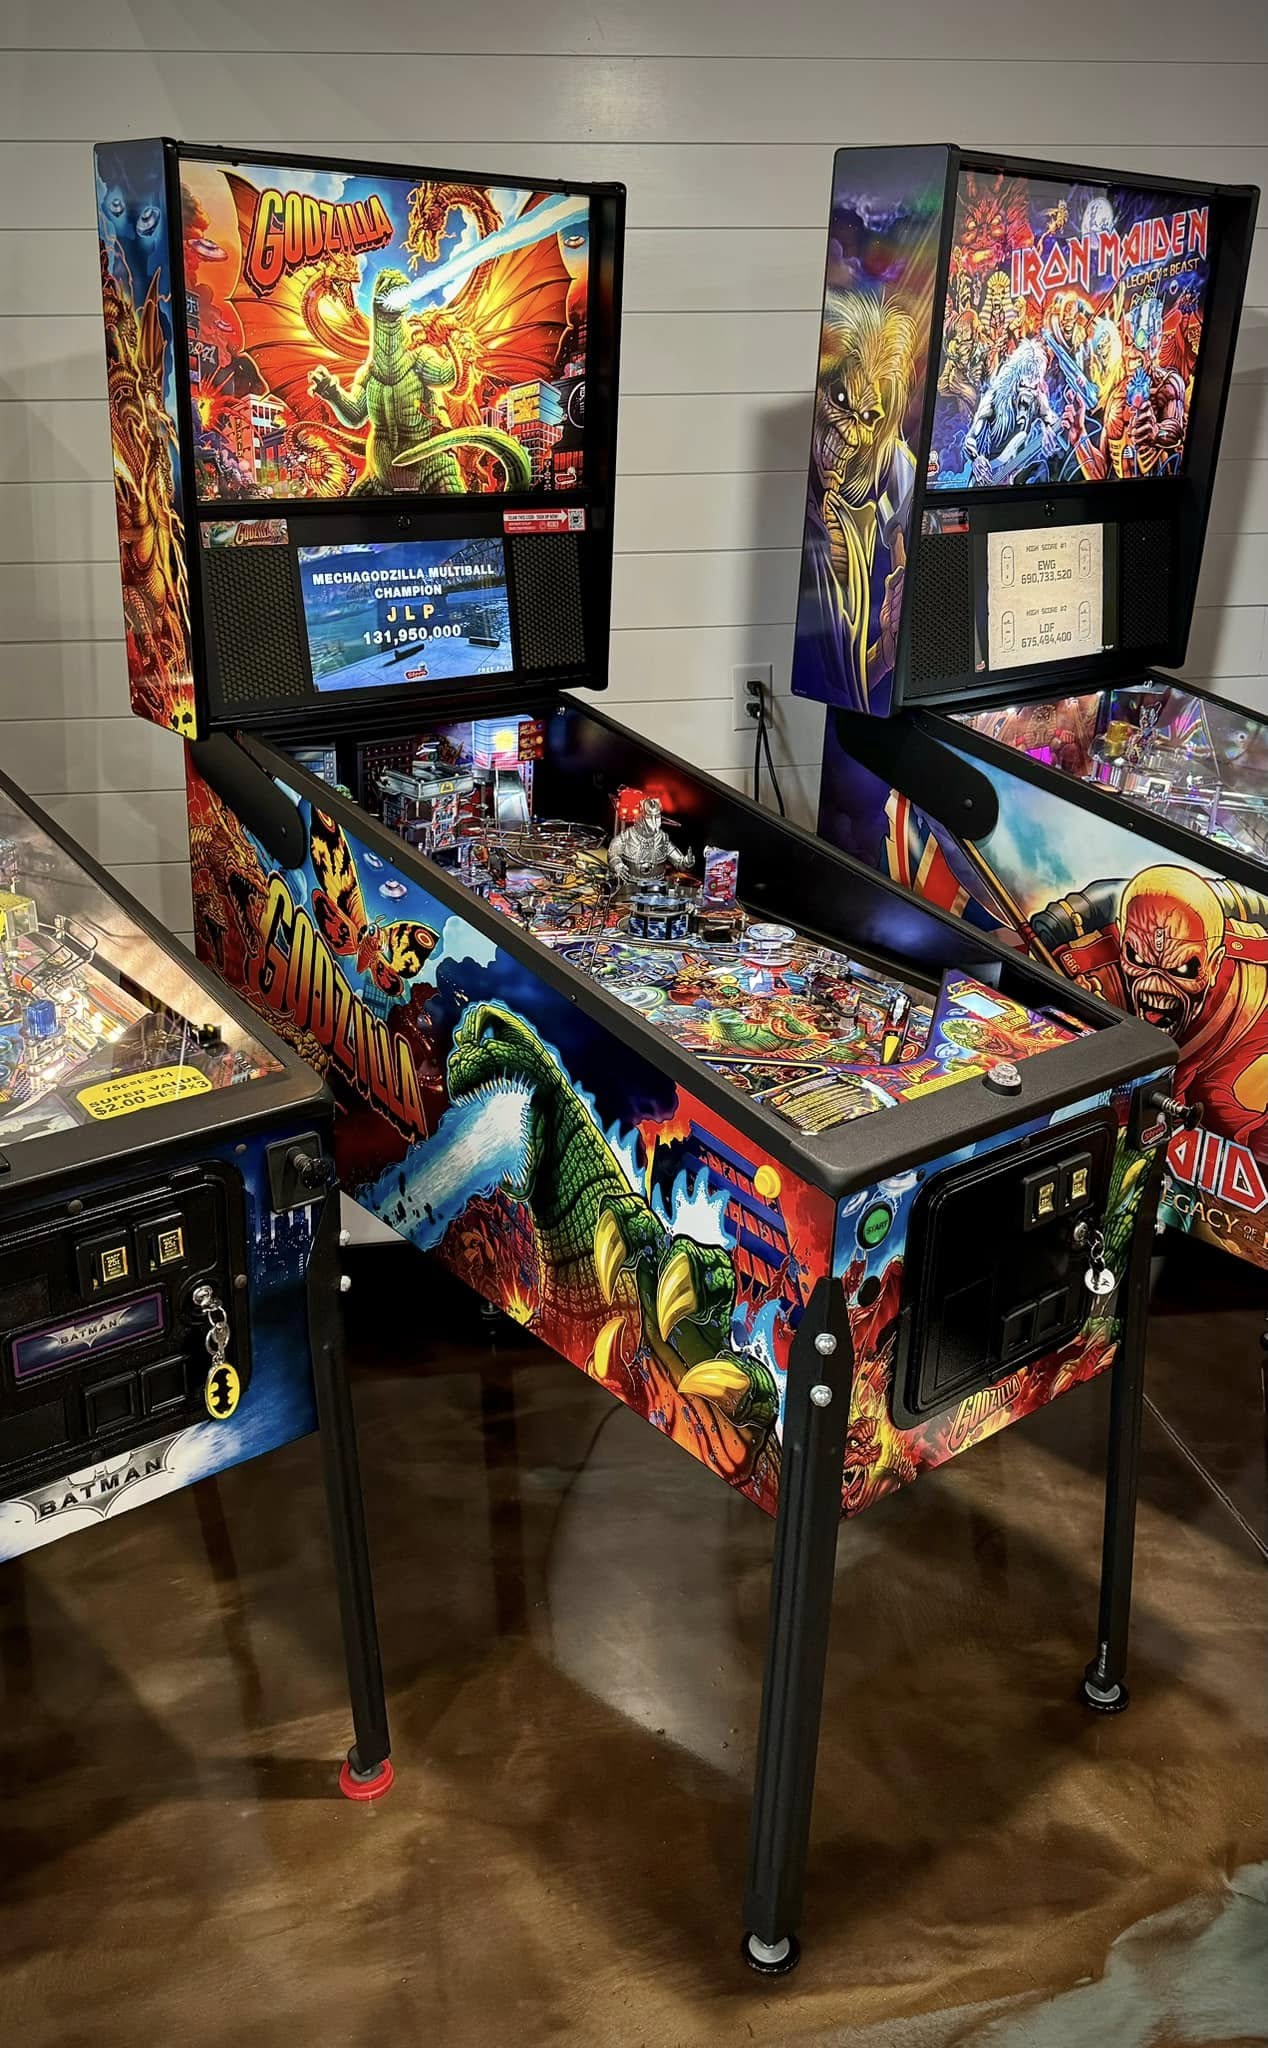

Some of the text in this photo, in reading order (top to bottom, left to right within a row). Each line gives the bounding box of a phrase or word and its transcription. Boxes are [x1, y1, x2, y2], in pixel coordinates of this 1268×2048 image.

[247, 188, 394, 289] GODZILLA
[1010, 206, 1209, 305] IRON MAIDEN
[1126, 268, 1162, 288] LEGACY
[1169, 258, 1200, 277] BEAST
[312, 564, 495, 586] MECHAGODZILLA MULTIBALL
[1021, 569, 1072, 585] 690,733,520
[1038, 560, 1056, 571] EWG
[374, 585, 442, 599] CHAMPION
[386, 604, 434, 622] J L P
[363, 624, 462, 646] 131,950,000
[1021, 631, 1072, 649] 675,494,400
[1063, 953, 1080, 973] 666
[252, 872, 428, 1139] GODZILLA
[89, 1075, 205, 1109] SUPER VALUE
[1161, 1184, 1239, 1233] EGACY
[866, 1219, 888, 1235] START
[60, 1319, 118, 1344] BATMAN
[949, 1375, 1020, 1451] GODZILLA
[39, 1456, 161, 1517] BATMAN
